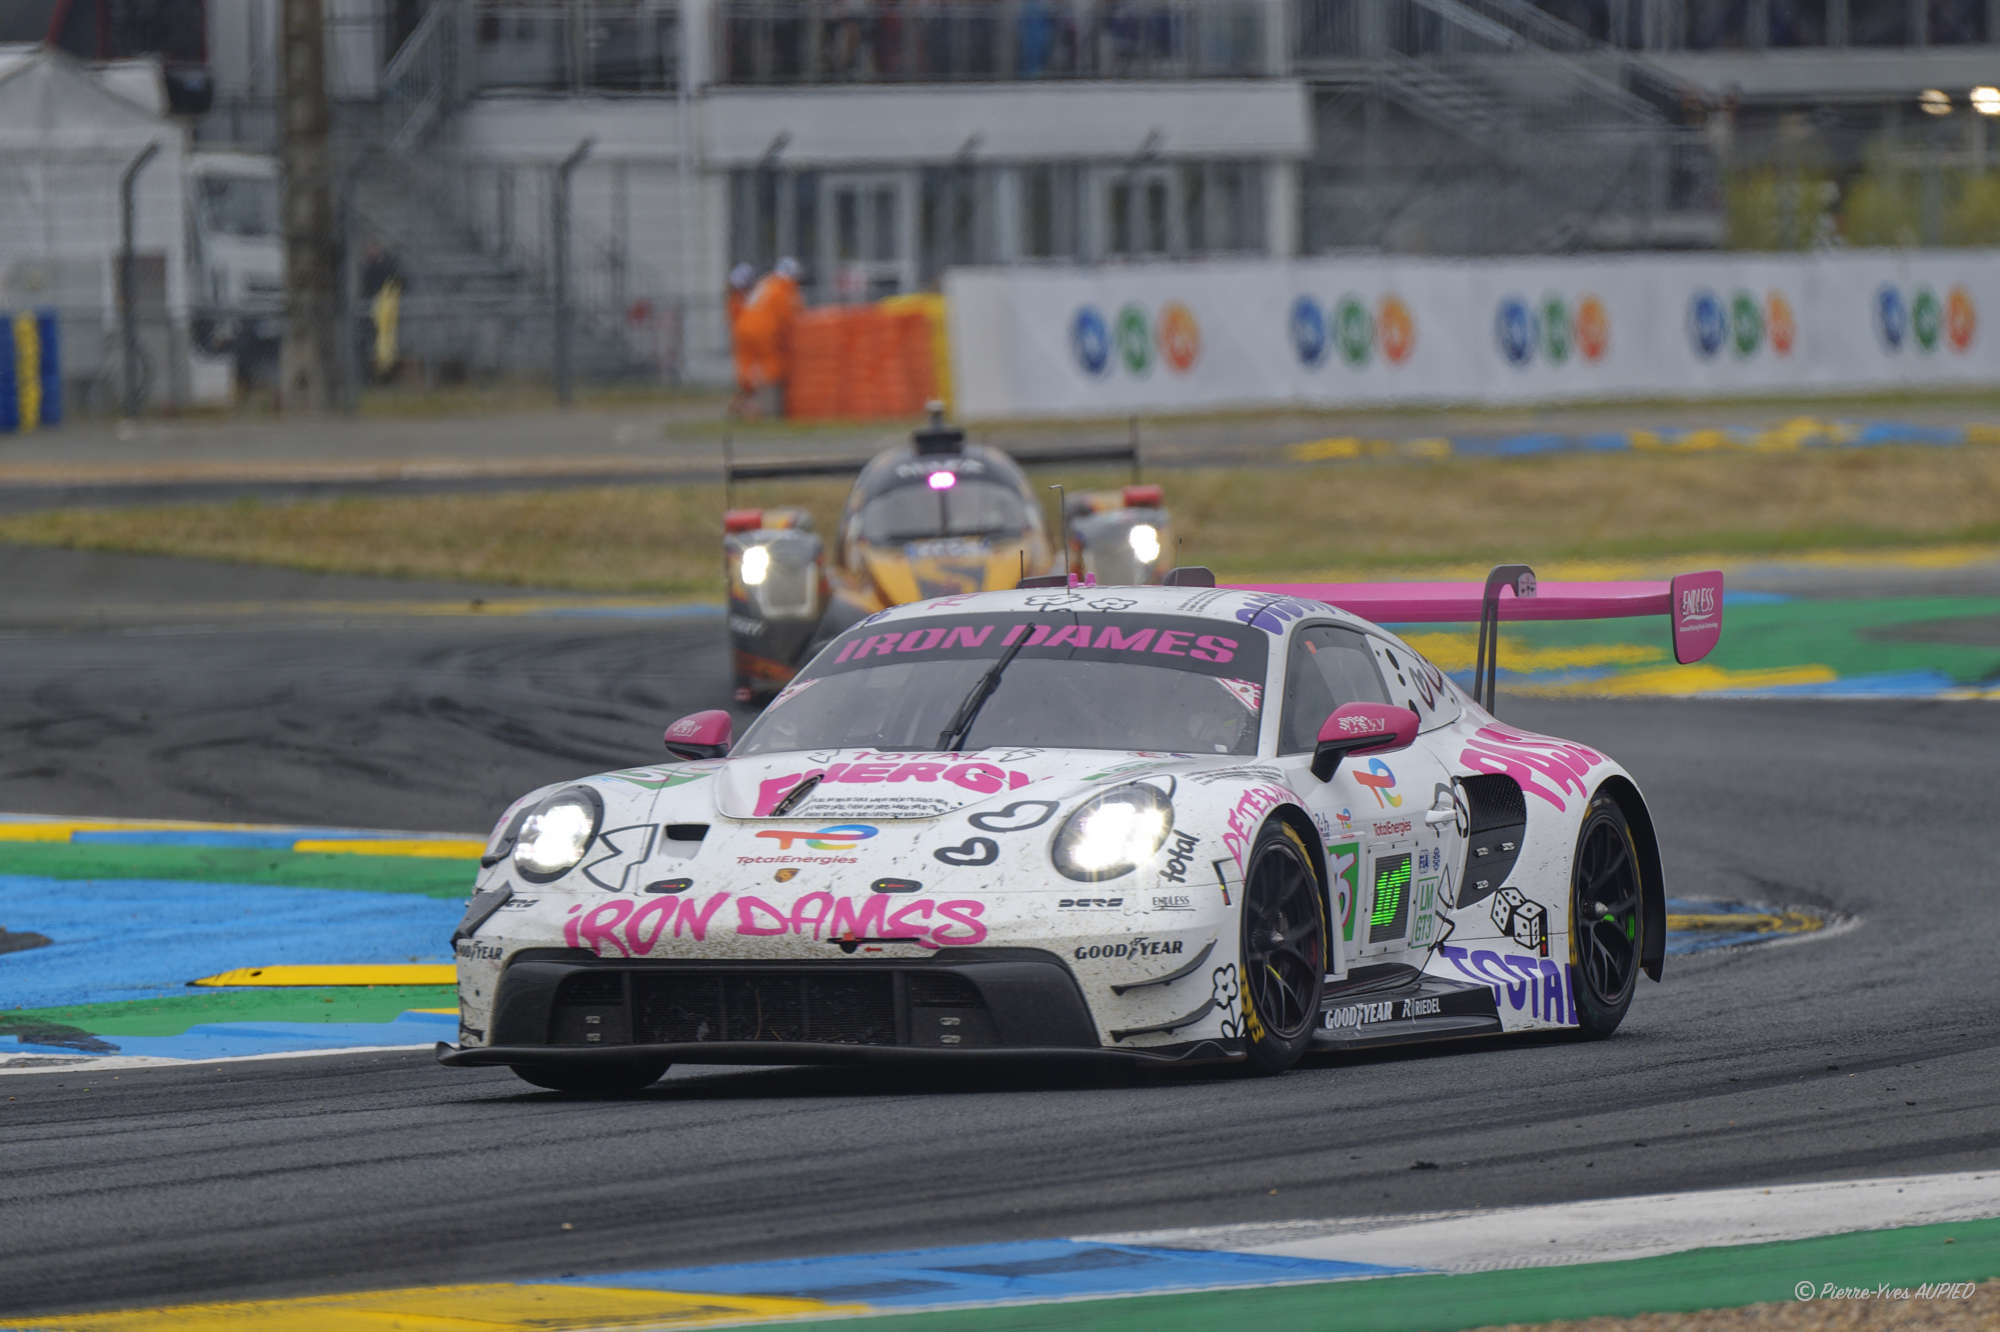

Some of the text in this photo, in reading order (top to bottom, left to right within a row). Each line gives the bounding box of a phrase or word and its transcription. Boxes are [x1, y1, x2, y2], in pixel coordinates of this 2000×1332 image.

[833, 624, 1239, 665] IRON DAMES
[736, 855, 859, 865] TotalEnergies
[1159, 829, 1200, 883] total
[1420, 882, 1434, 911] LM
[1415, 914, 1433, 942] GT3
[1415, 998, 1441, 1016] RIEDEL
